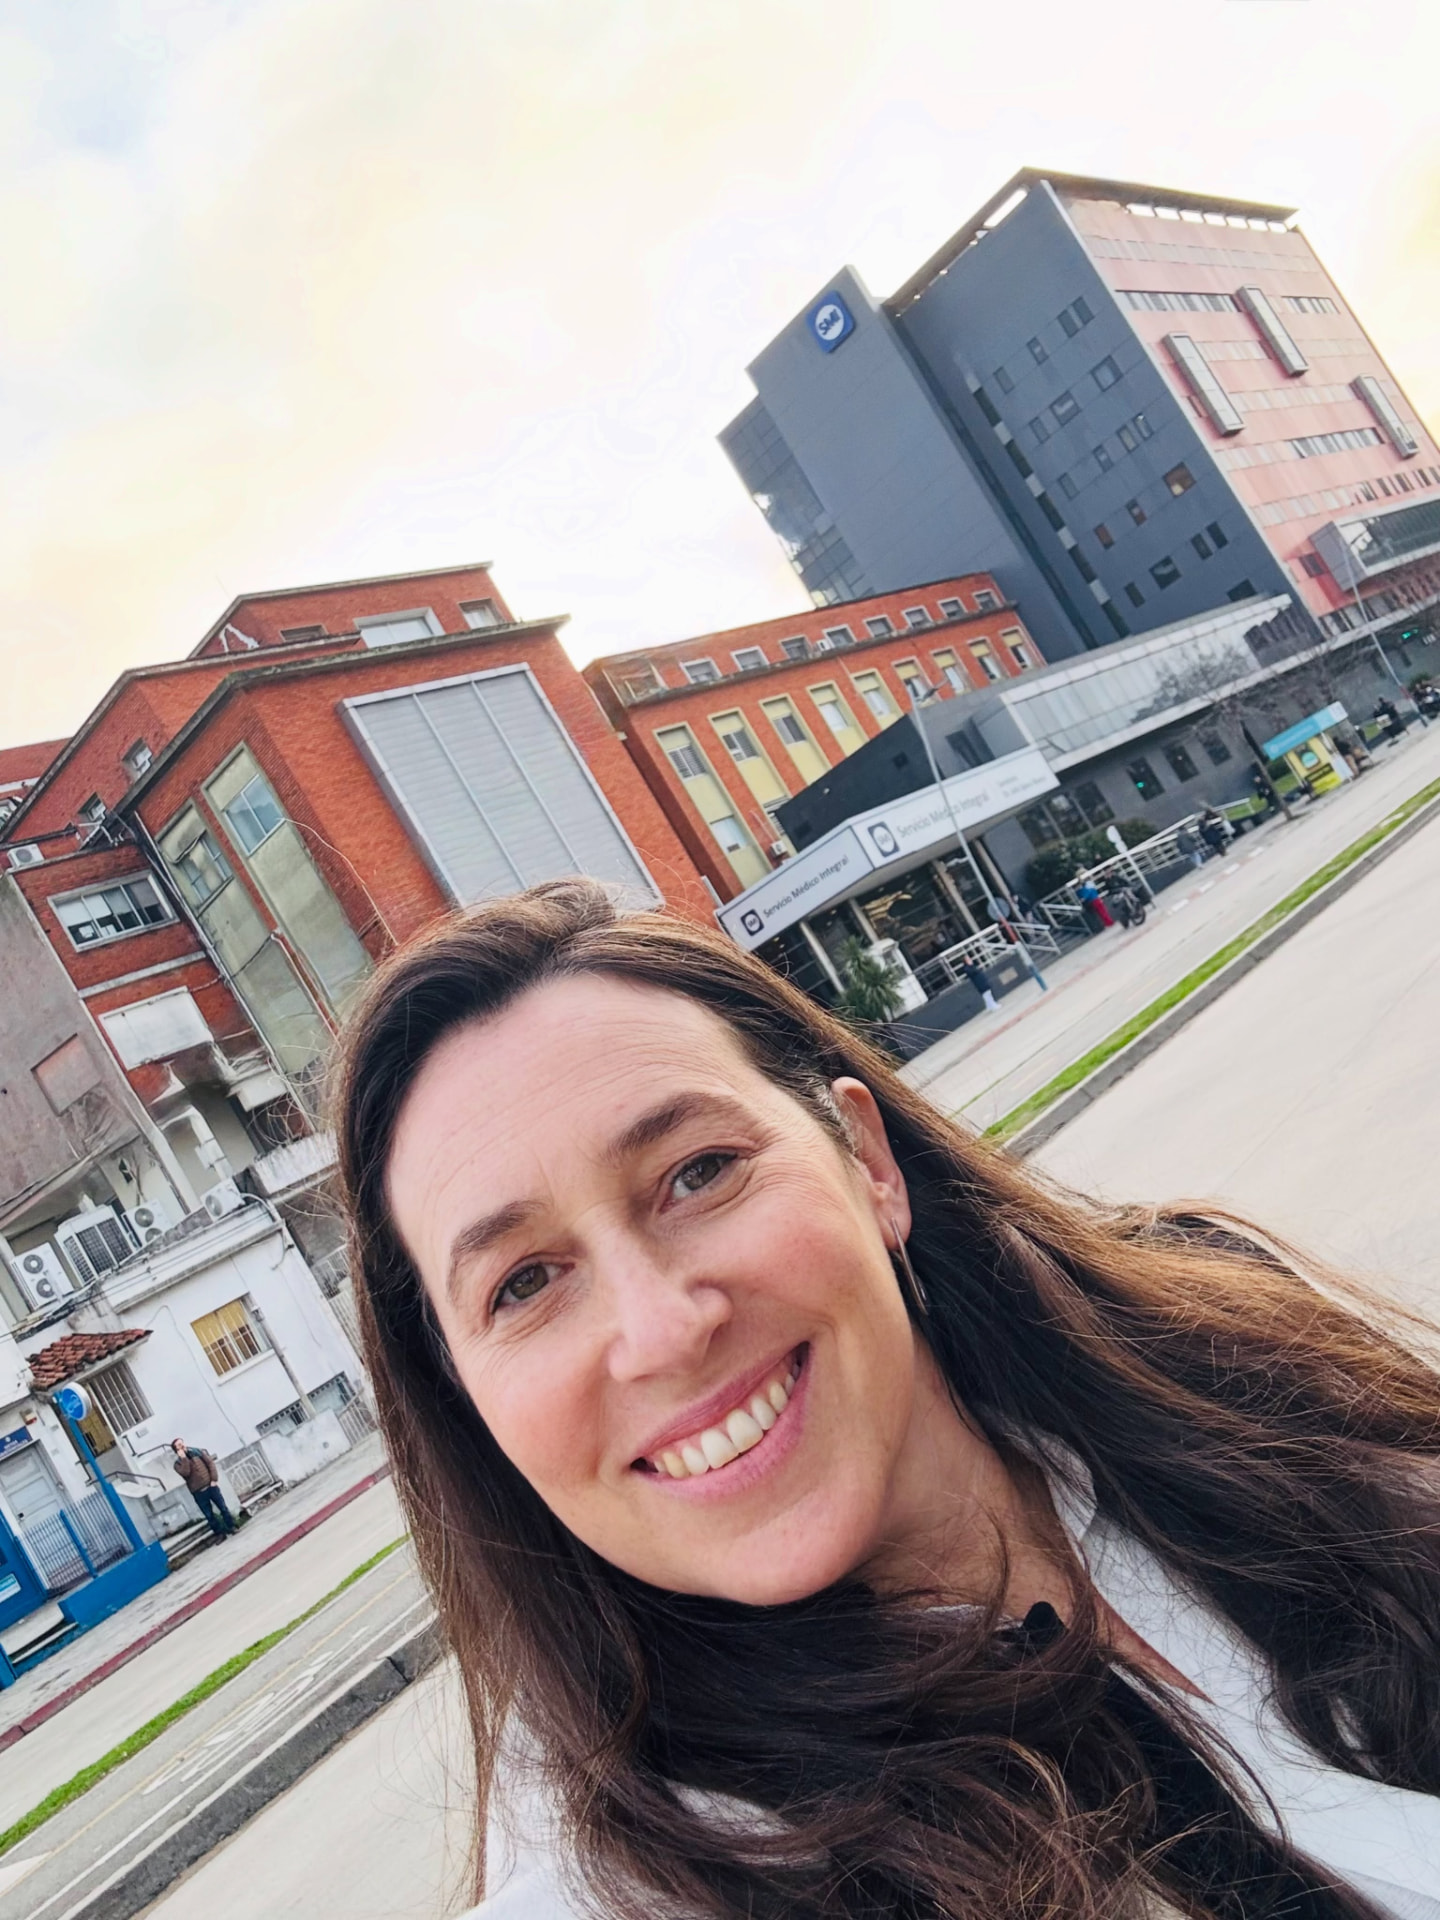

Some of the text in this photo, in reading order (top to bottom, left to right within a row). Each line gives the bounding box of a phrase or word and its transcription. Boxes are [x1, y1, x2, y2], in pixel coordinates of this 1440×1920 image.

[818, 308, 841, 336] SMI
[896, 815, 931, 837] Servicio
[960, 789, 990, 811] Integral
[763, 854, 850, 918] Servicio Médico Integral
